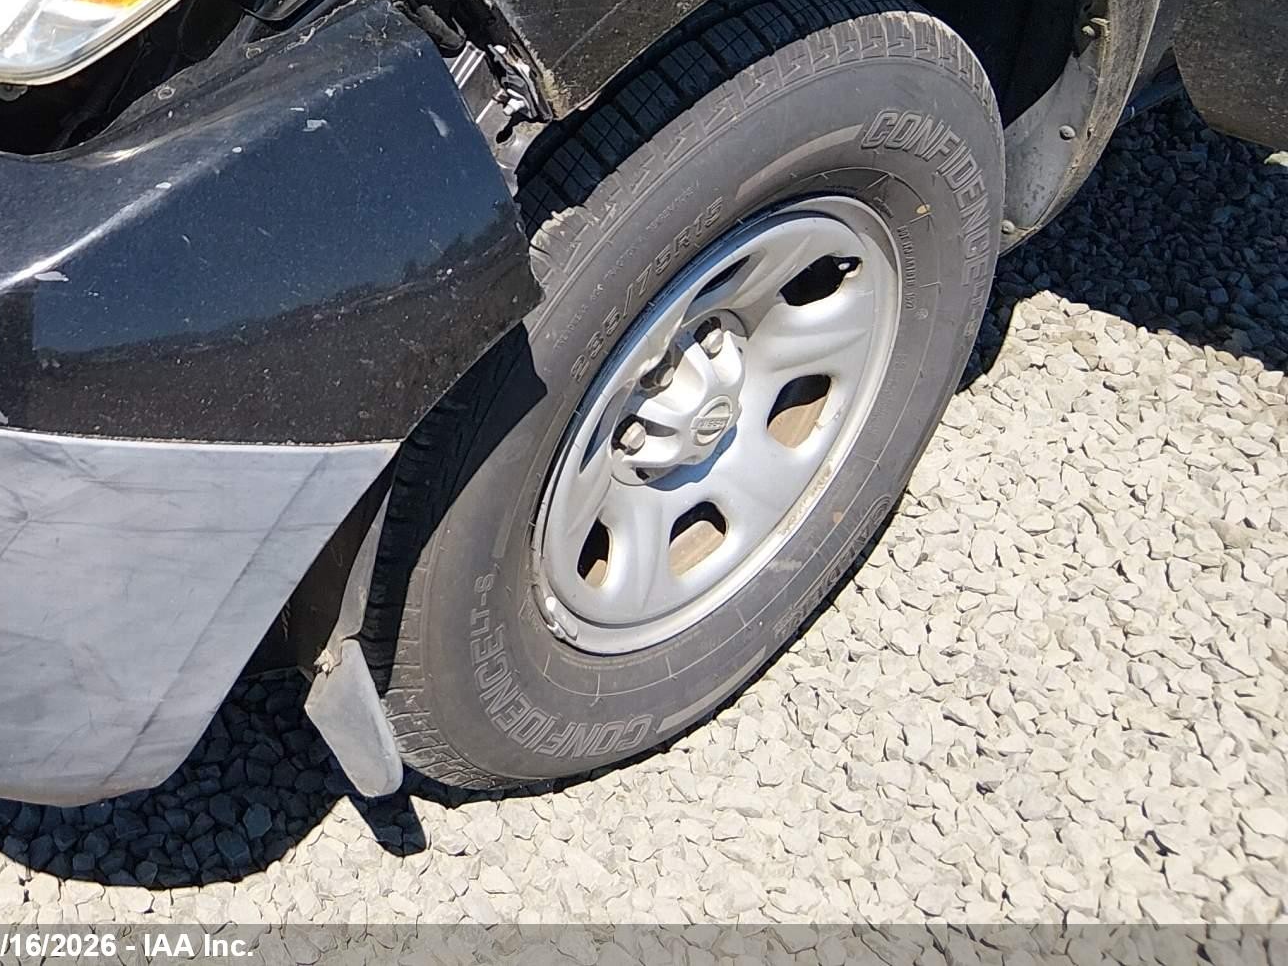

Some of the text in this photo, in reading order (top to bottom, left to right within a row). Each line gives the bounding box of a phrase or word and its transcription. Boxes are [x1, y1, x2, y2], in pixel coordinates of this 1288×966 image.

[861, 108, 991, 288] CONFIDENCE
[571, 196, 723, 382] 235/75R15
[471, 624, 653, 760] CONFIDENCE
